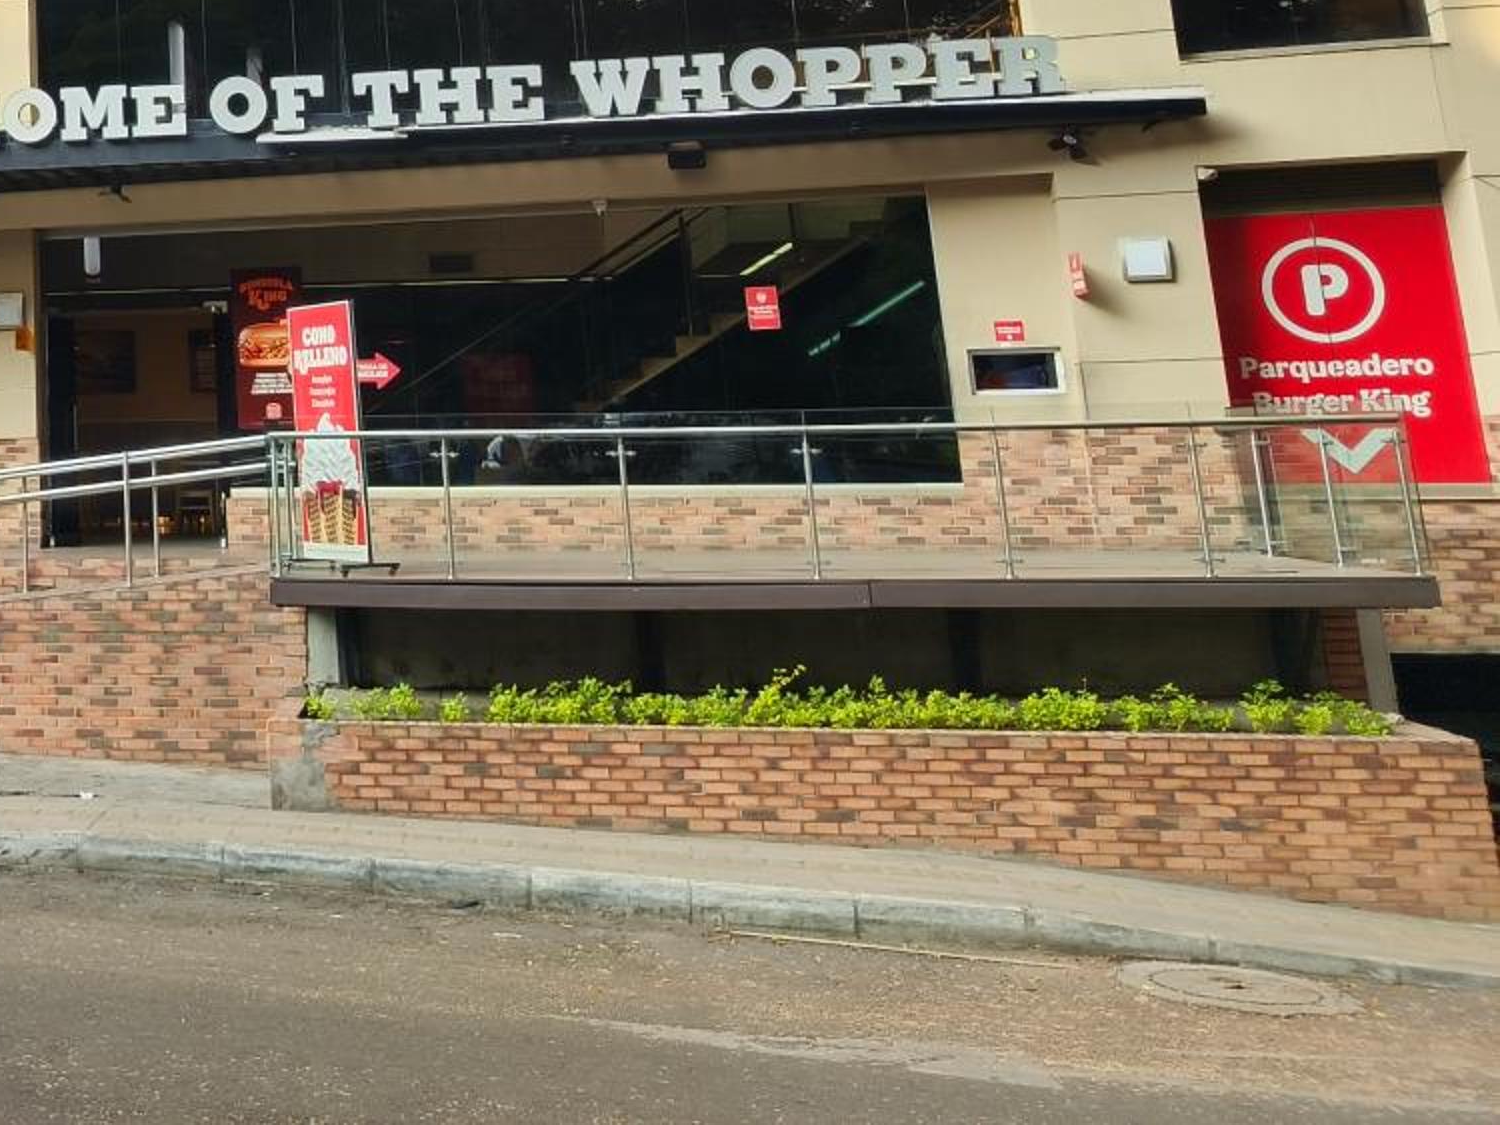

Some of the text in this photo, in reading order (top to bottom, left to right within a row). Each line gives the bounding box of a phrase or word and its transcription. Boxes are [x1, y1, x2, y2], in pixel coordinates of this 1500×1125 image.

[209, 74, 325, 134] OF
[354, 63, 547, 129] THE
[569, 35, 1066, 119] WHOPPER
[1301, 263, 1349, 316] P
[302, 325, 336, 347] CONO
[1239, 353, 1434, 383] Parqueadero
[1253, 388, 1432, 417] Burger King
